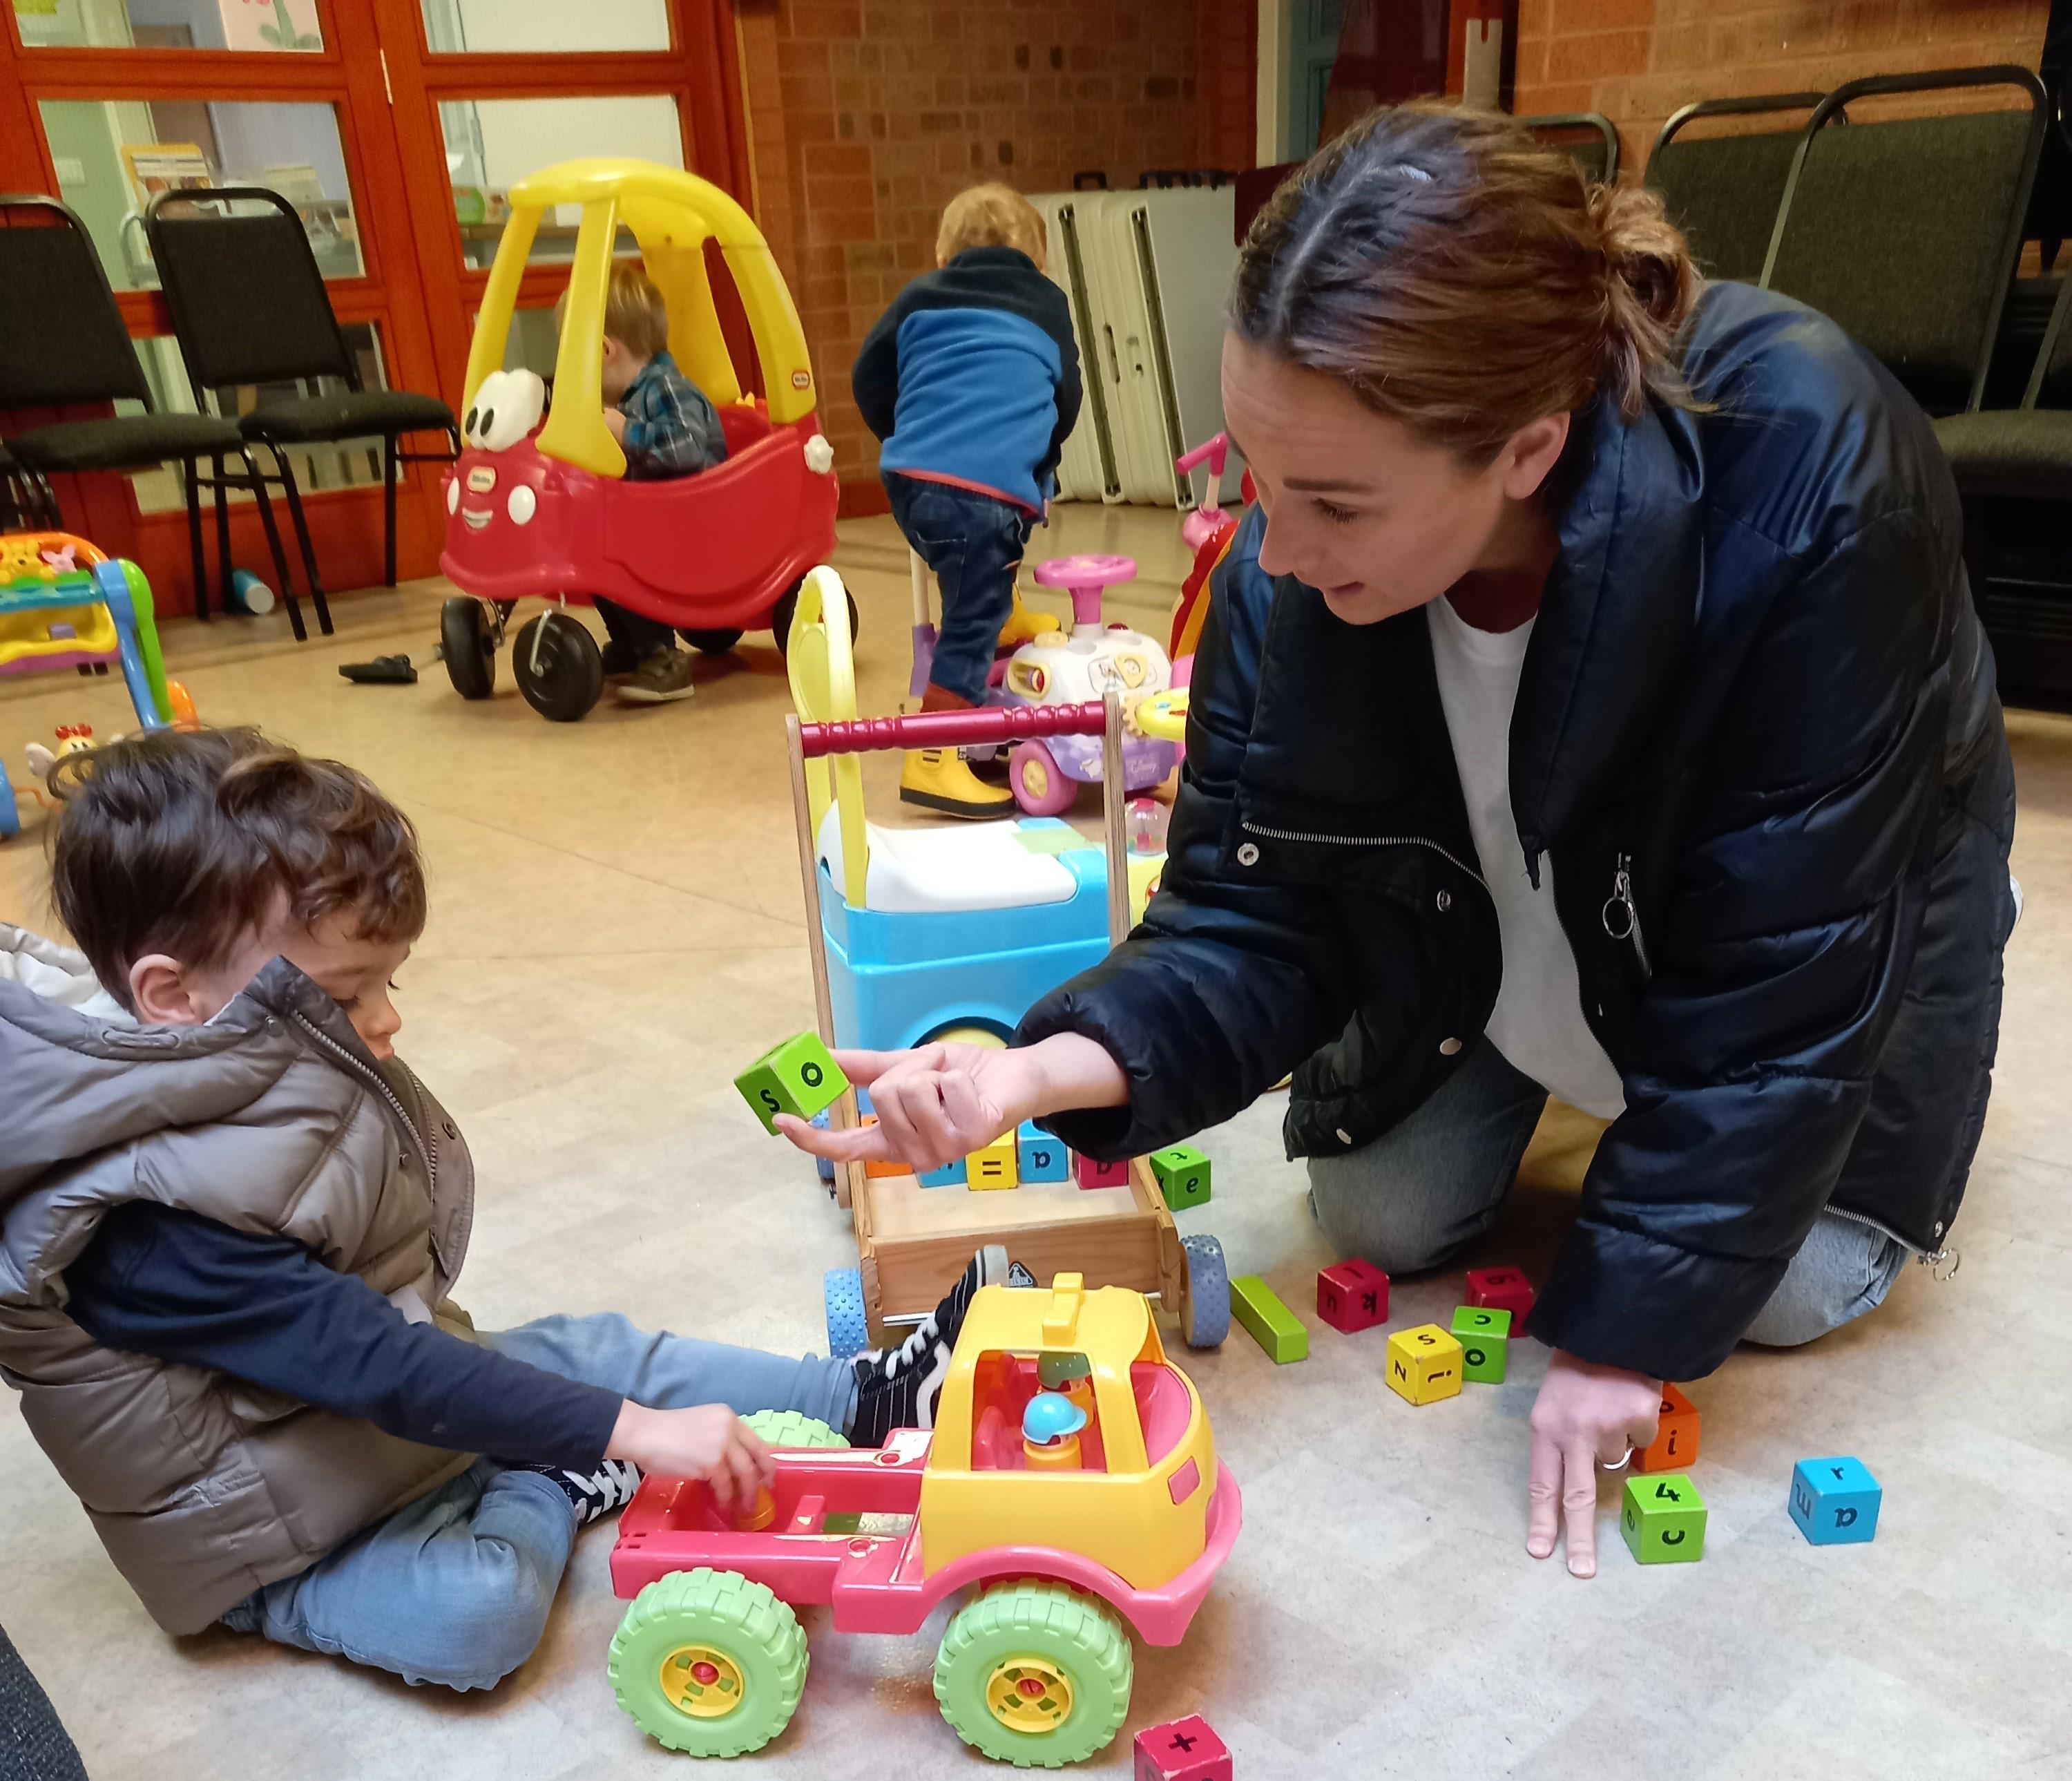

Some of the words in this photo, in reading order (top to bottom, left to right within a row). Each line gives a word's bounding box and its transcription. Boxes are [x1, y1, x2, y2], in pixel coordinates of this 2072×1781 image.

[1186, 1177, 1199, 1194] e
[1667, 1429, 1678, 1456] i
[1655, 1482, 1681, 1503] 4
